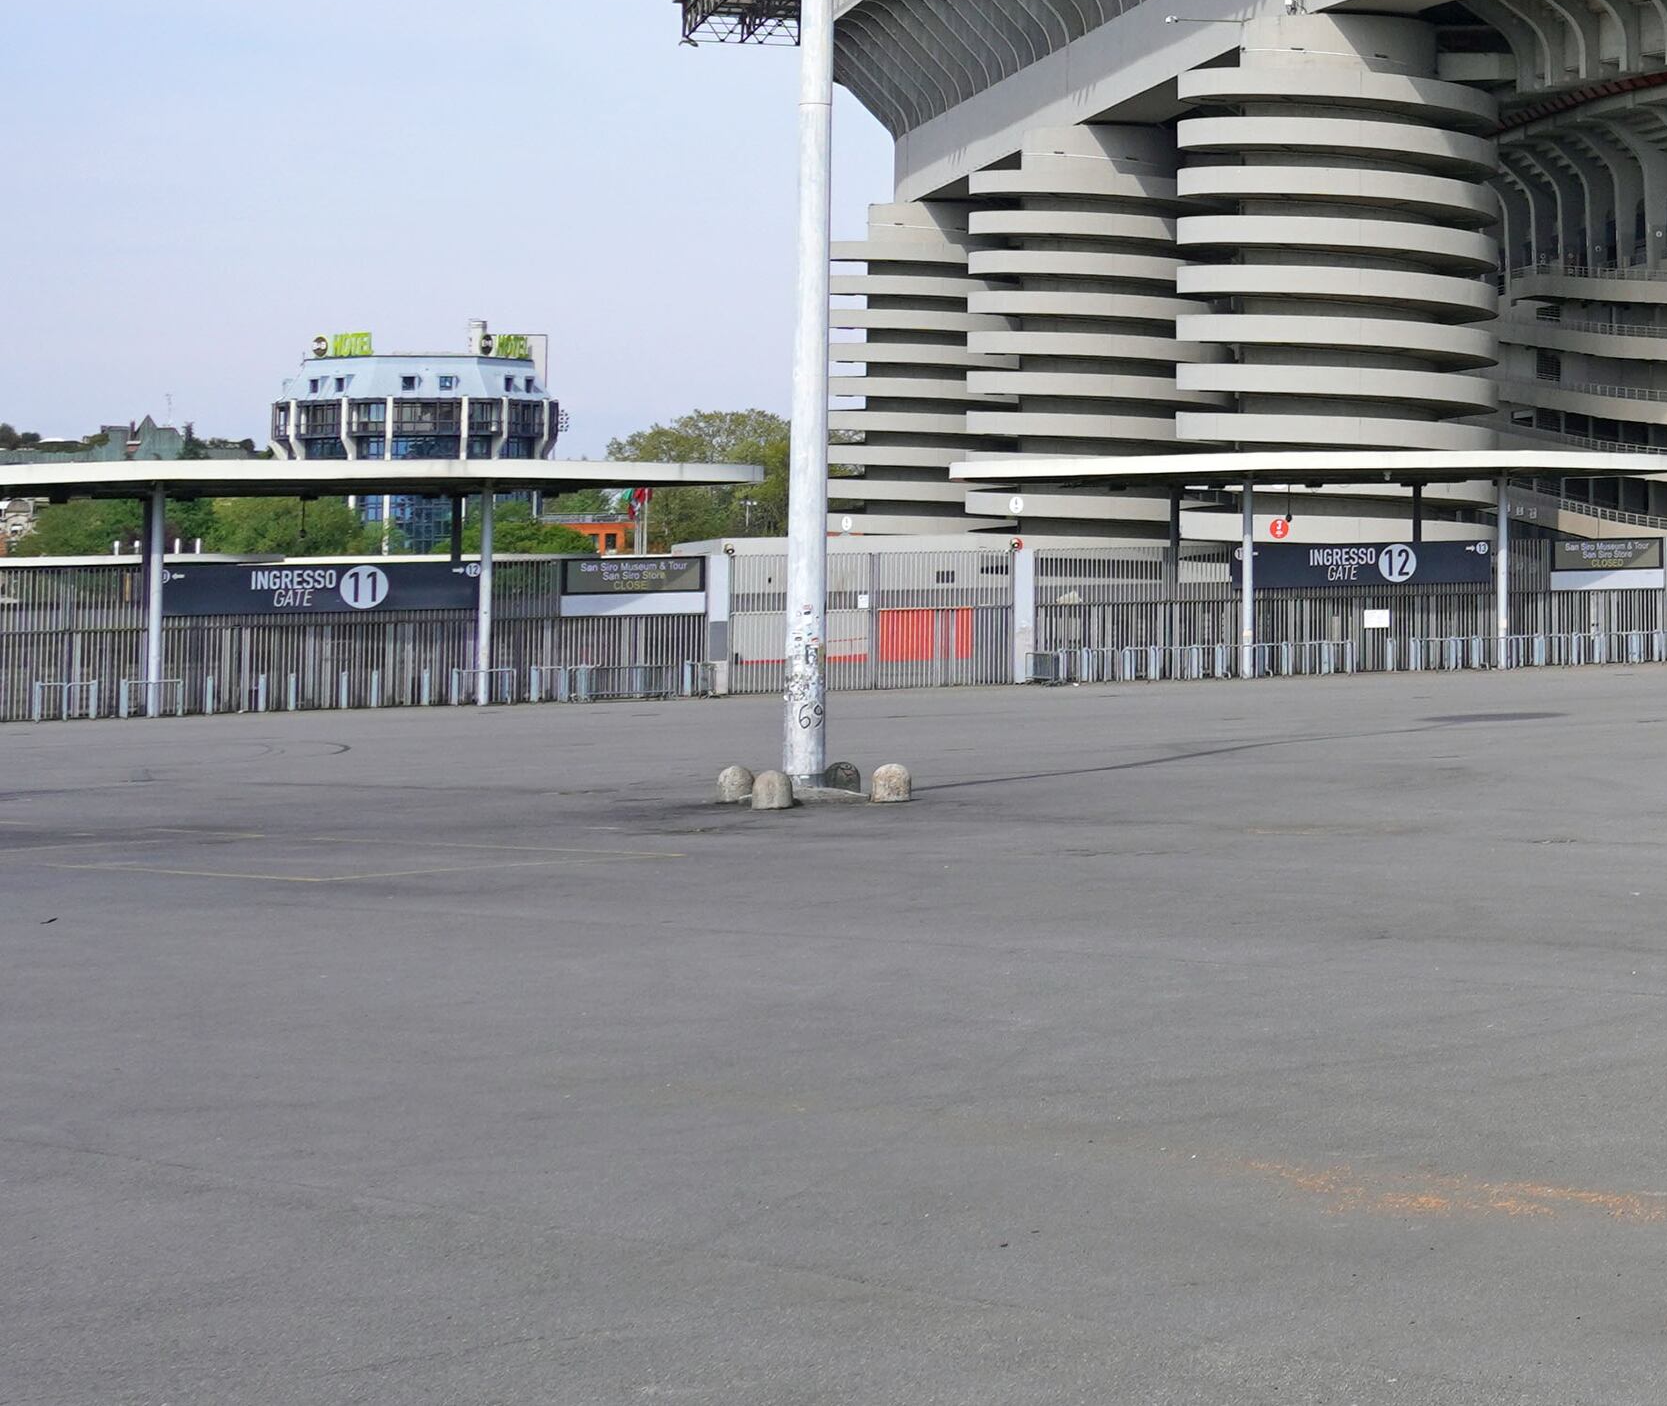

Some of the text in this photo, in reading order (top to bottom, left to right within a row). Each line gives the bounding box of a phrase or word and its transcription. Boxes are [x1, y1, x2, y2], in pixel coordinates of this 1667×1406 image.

[333, 332, 373, 356] HOTEL
[496, 335, 530, 358] HOTEL
[580, 560, 688, 572] San Siro Museum & Tour
[1309, 547, 1410, 577] INGRESSO 12
[1591, 559, 1624, 568] CLOSED
[602, 570, 667, 581] San Siro Store
[1327, 564, 1359, 581] GATE
[251, 569, 378, 603] INGRESSO 11
[273, 589, 314, 607] GATE
